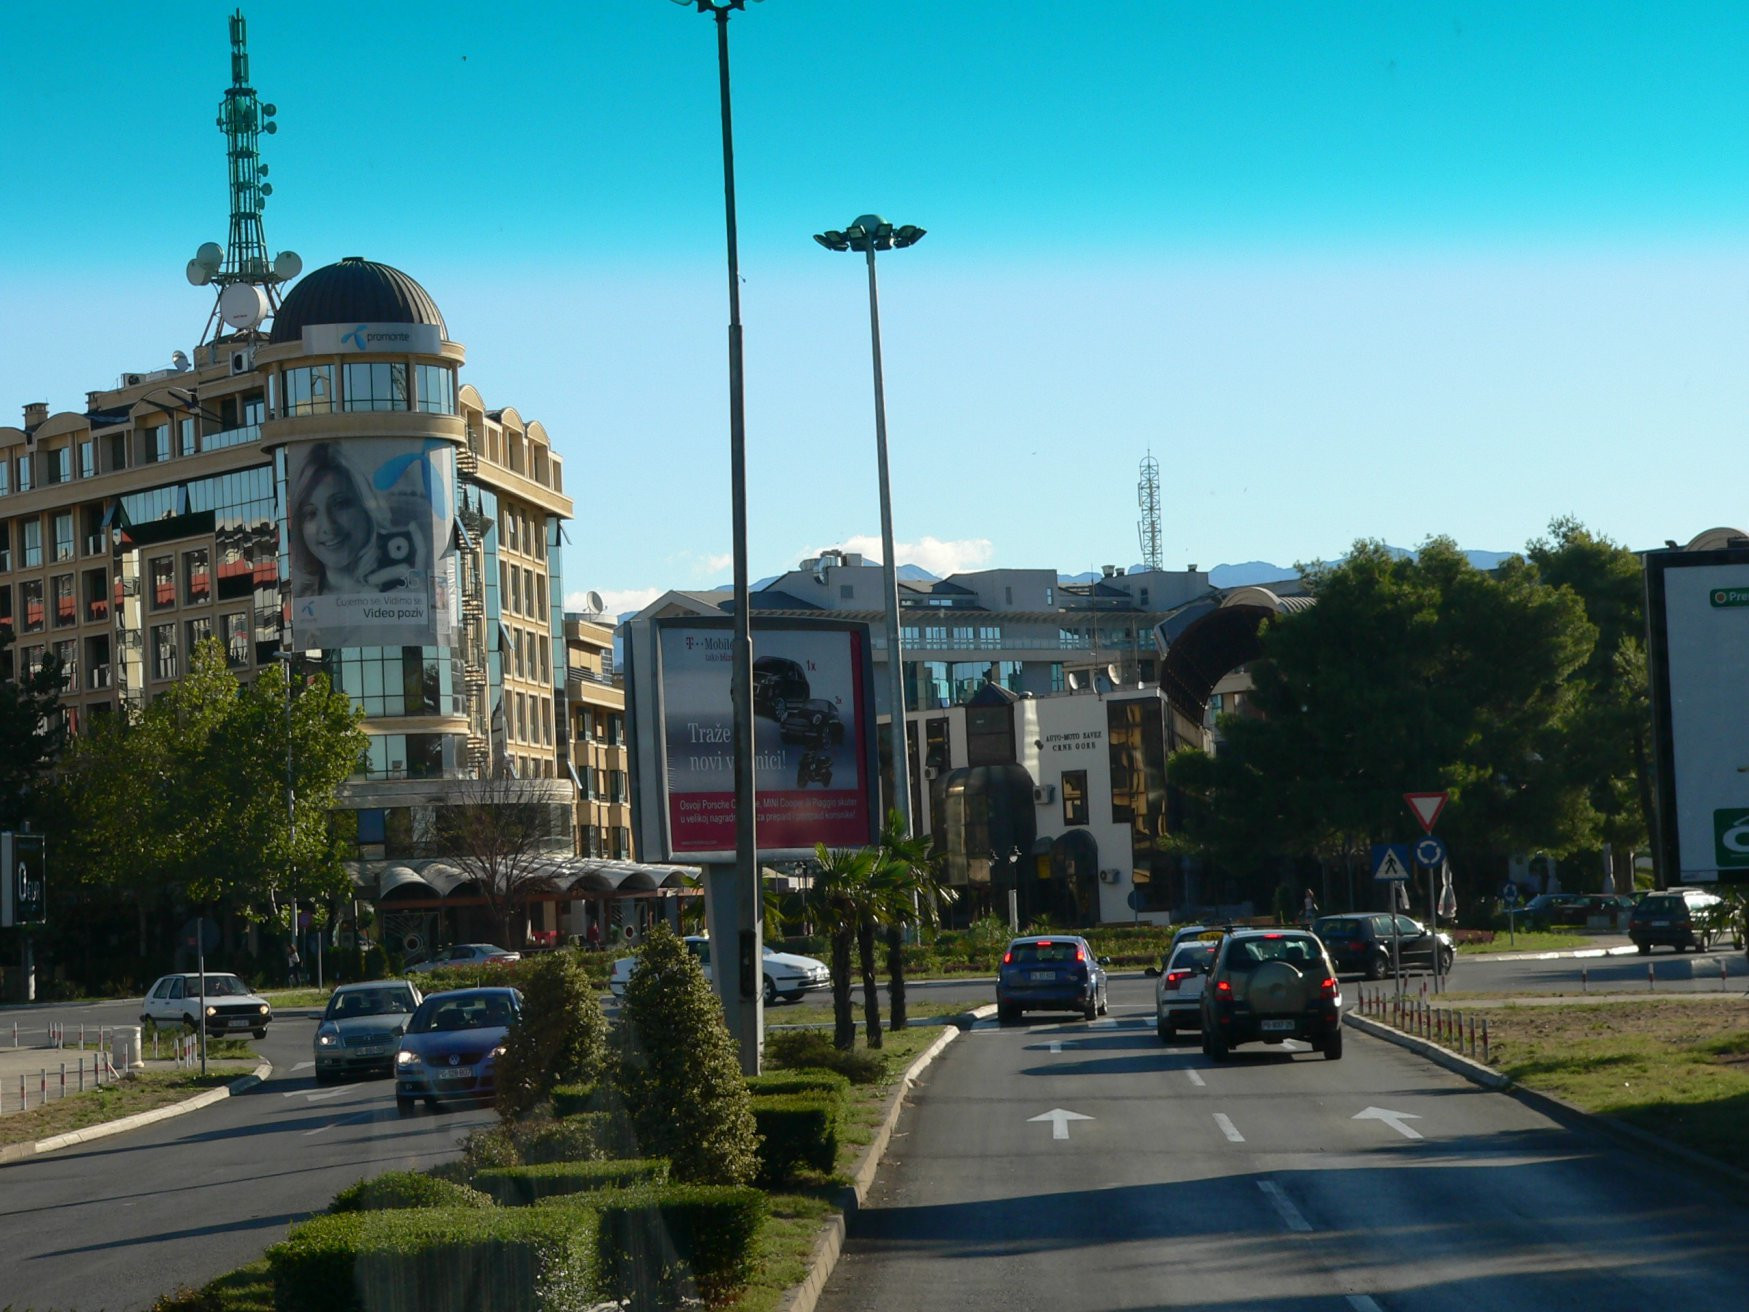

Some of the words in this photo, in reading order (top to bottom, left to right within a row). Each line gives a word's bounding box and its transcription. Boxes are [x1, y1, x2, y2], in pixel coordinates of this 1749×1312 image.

[367, 332, 410, 344] promonte
[363, 607, 395, 618] Video
[397, 608, 424, 621] poziv
[688, 721, 731, 743] Traže
[690, 751, 722, 770] novi
